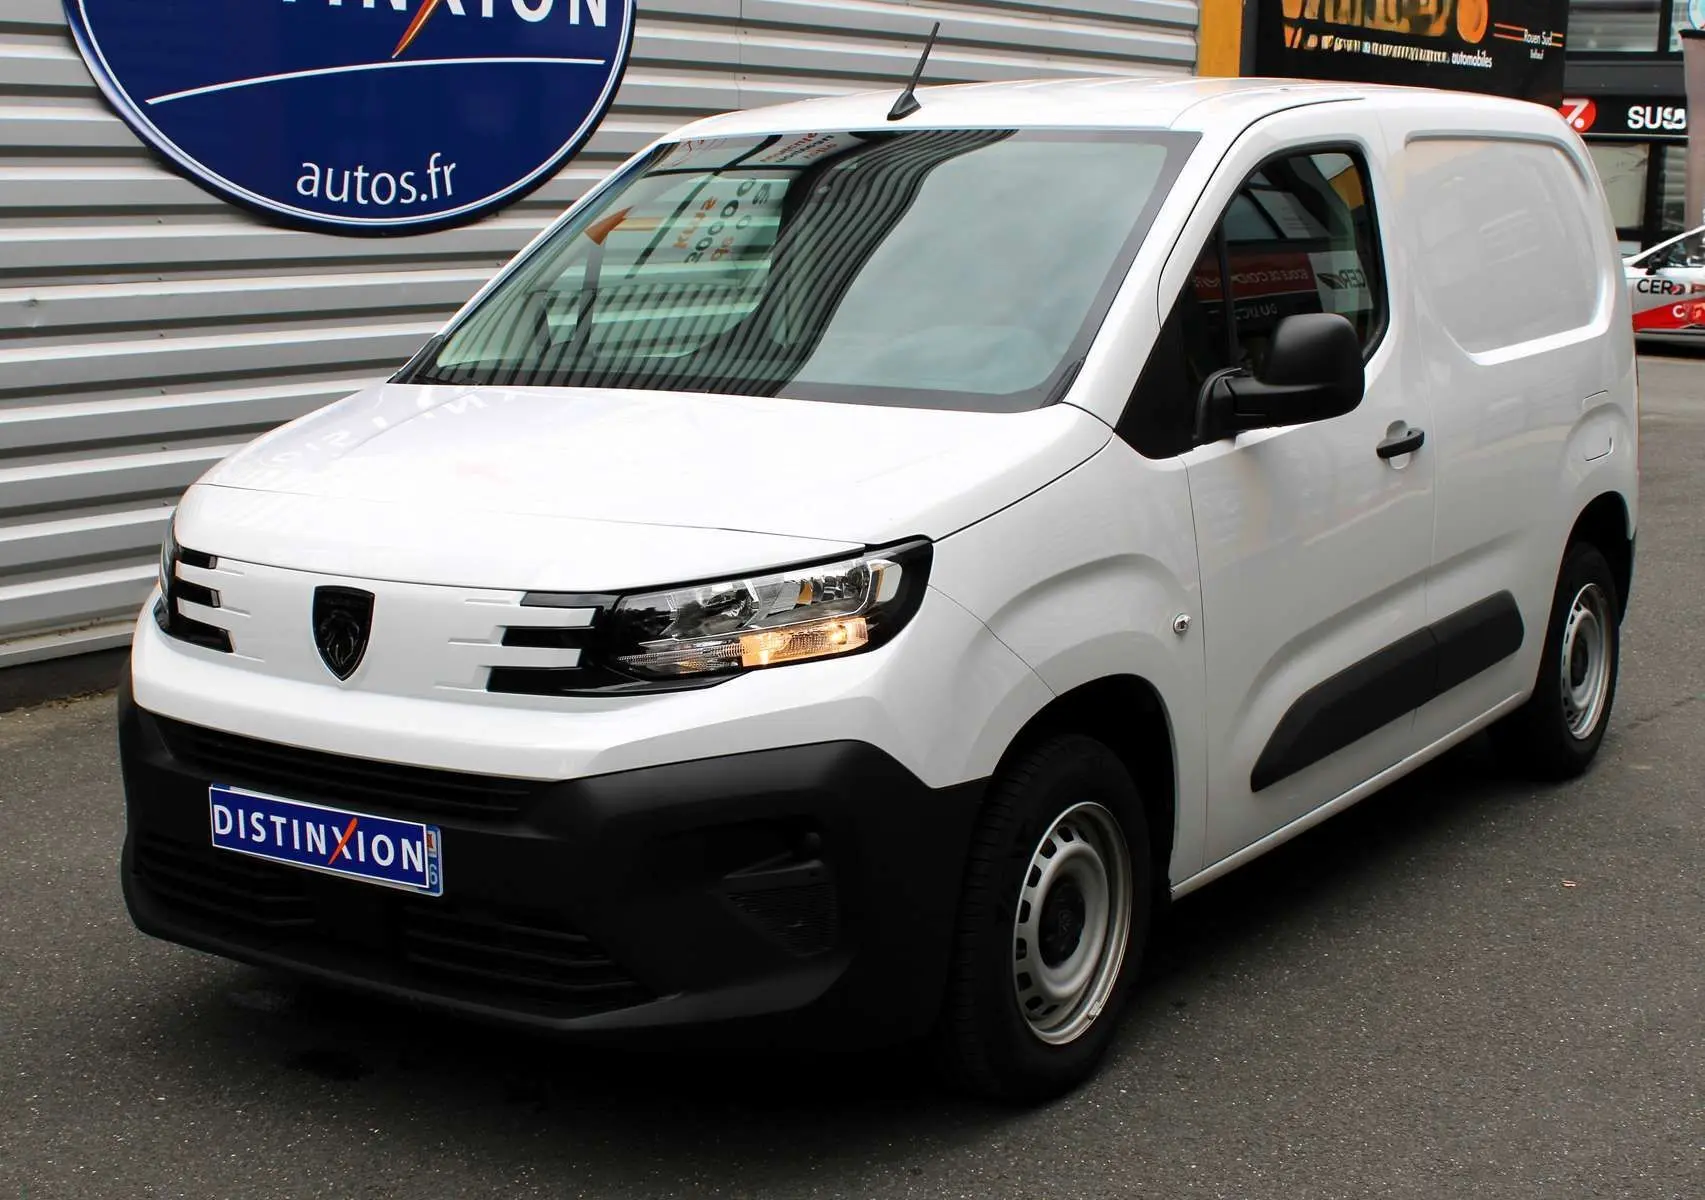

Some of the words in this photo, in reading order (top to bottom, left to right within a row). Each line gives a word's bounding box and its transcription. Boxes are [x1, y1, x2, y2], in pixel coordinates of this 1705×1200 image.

[1451, 49, 1493, 68] automobiles
[296, 152, 457, 206] autos.fr
[213, 804, 424, 873] DISTINXION
